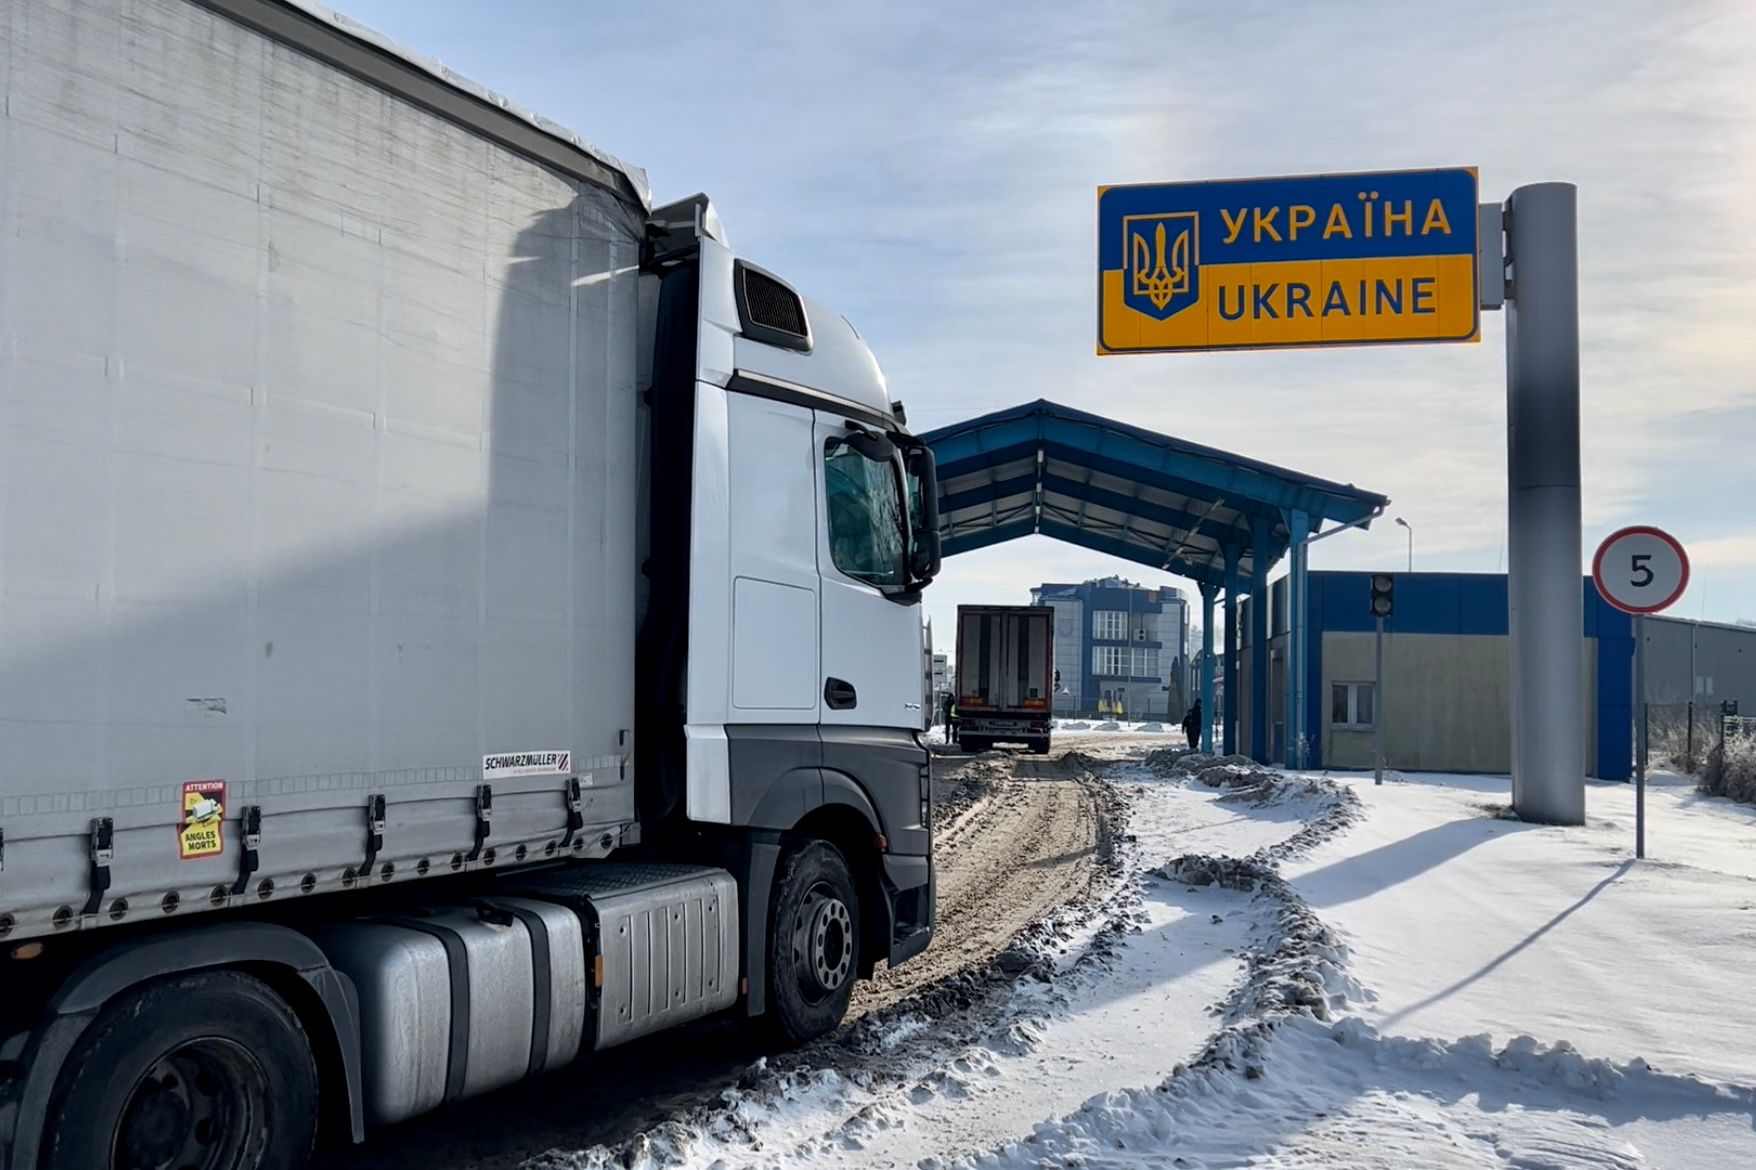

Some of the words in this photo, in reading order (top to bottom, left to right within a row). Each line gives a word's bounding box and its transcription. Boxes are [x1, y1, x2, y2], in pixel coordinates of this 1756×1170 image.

[1219, 191, 1453, 244] УКРАЇНА
[1217, 276, 1437, 321] UKRAINE
[1630, 554, 1655, 588] 5
[484, 753, 558, 771] SCHWARZMÜLLER
[184, 781, 224, 792] ATTENTION
[185, 831, 216, 842] ANGLES
[188, 840, 217, 851] MORTS
